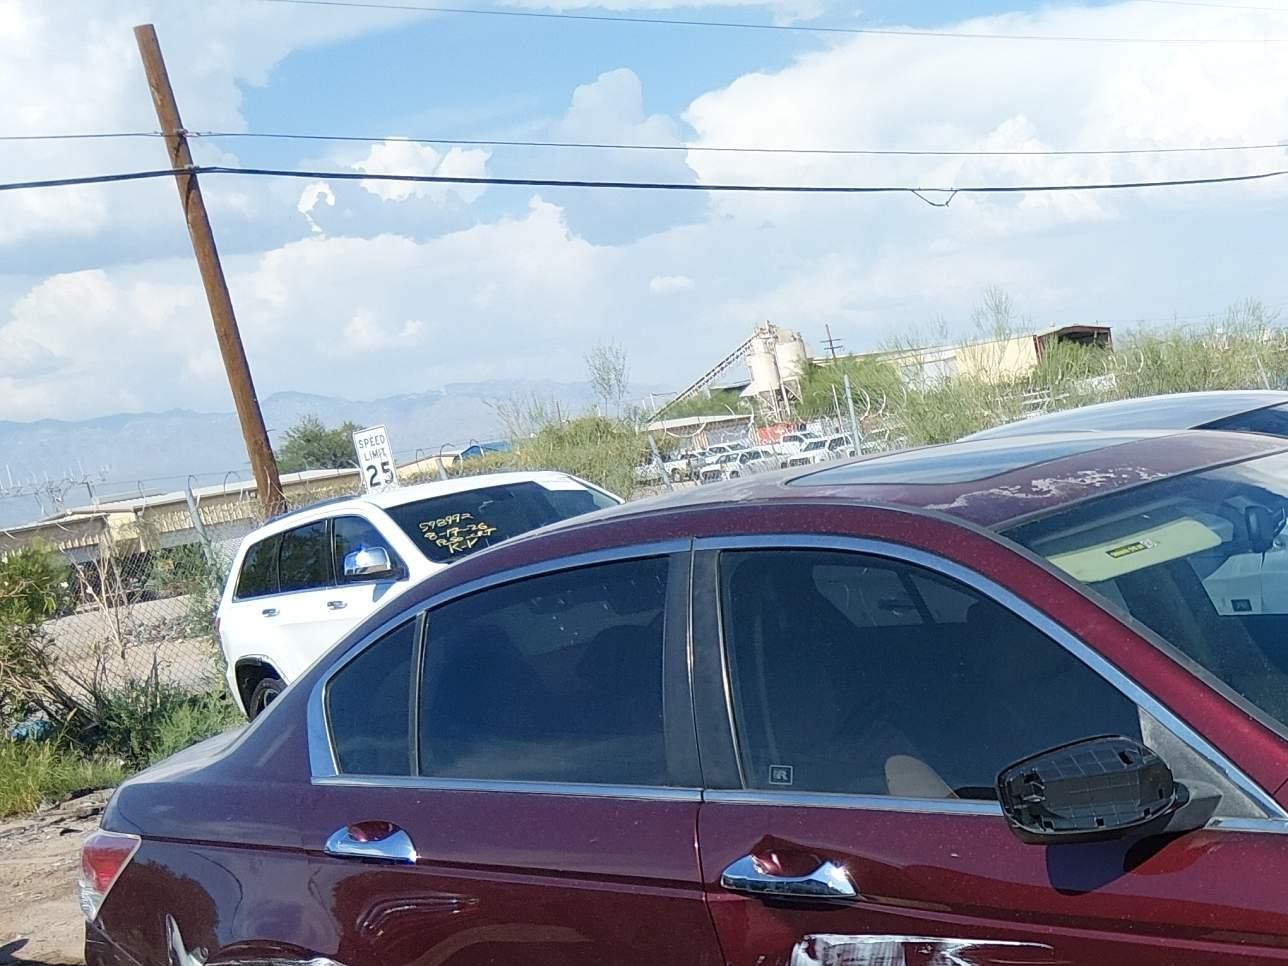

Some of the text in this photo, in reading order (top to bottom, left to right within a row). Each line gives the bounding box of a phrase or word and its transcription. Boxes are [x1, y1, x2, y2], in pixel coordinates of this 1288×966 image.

[358, 434, 386, 449] SPEED
[363, 447, 387, 462] LIMIT
[366, 461, 394, 488] 25
